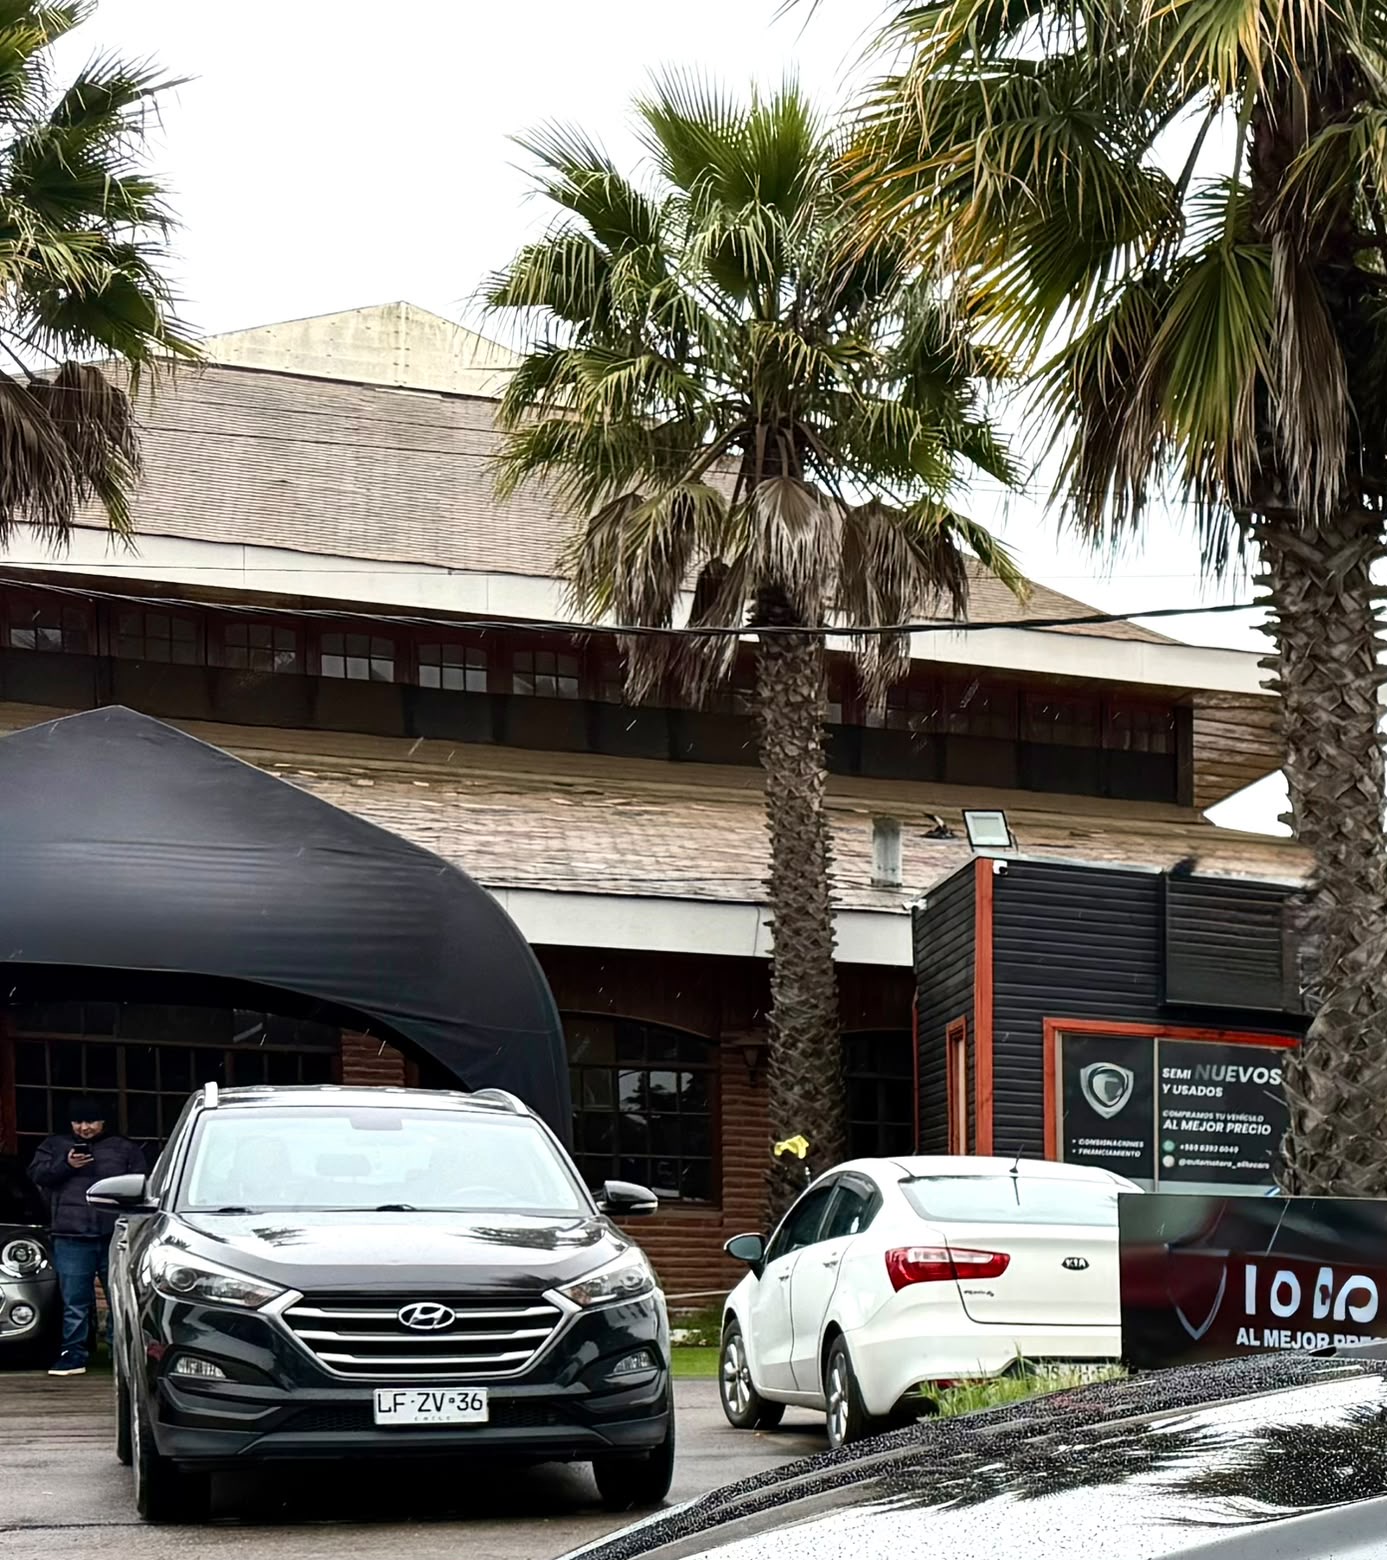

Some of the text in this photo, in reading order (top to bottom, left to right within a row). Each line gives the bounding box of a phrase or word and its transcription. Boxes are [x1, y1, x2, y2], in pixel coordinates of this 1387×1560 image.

[1162, 1064, 1282, 1085] SEMI NUEVOS
[1162, 1084, 1223, 1097] Y USADOS
[1163, 1110, 1213, 1119] COMPRAMOS
[1163, 1119, 1271, 1135] AL MEJOR PRECIO
[1078, 1138, 1144, 1148] CONSIGNACIONES
[1078, 1147, 1141, 1157] FINANCIAMIENTO
[1065, 1257, 1087, 1268] KIA
[1236, 1327, 1260, 1346] AL
[1264, 1328, 1329, 1349] MEJOR
